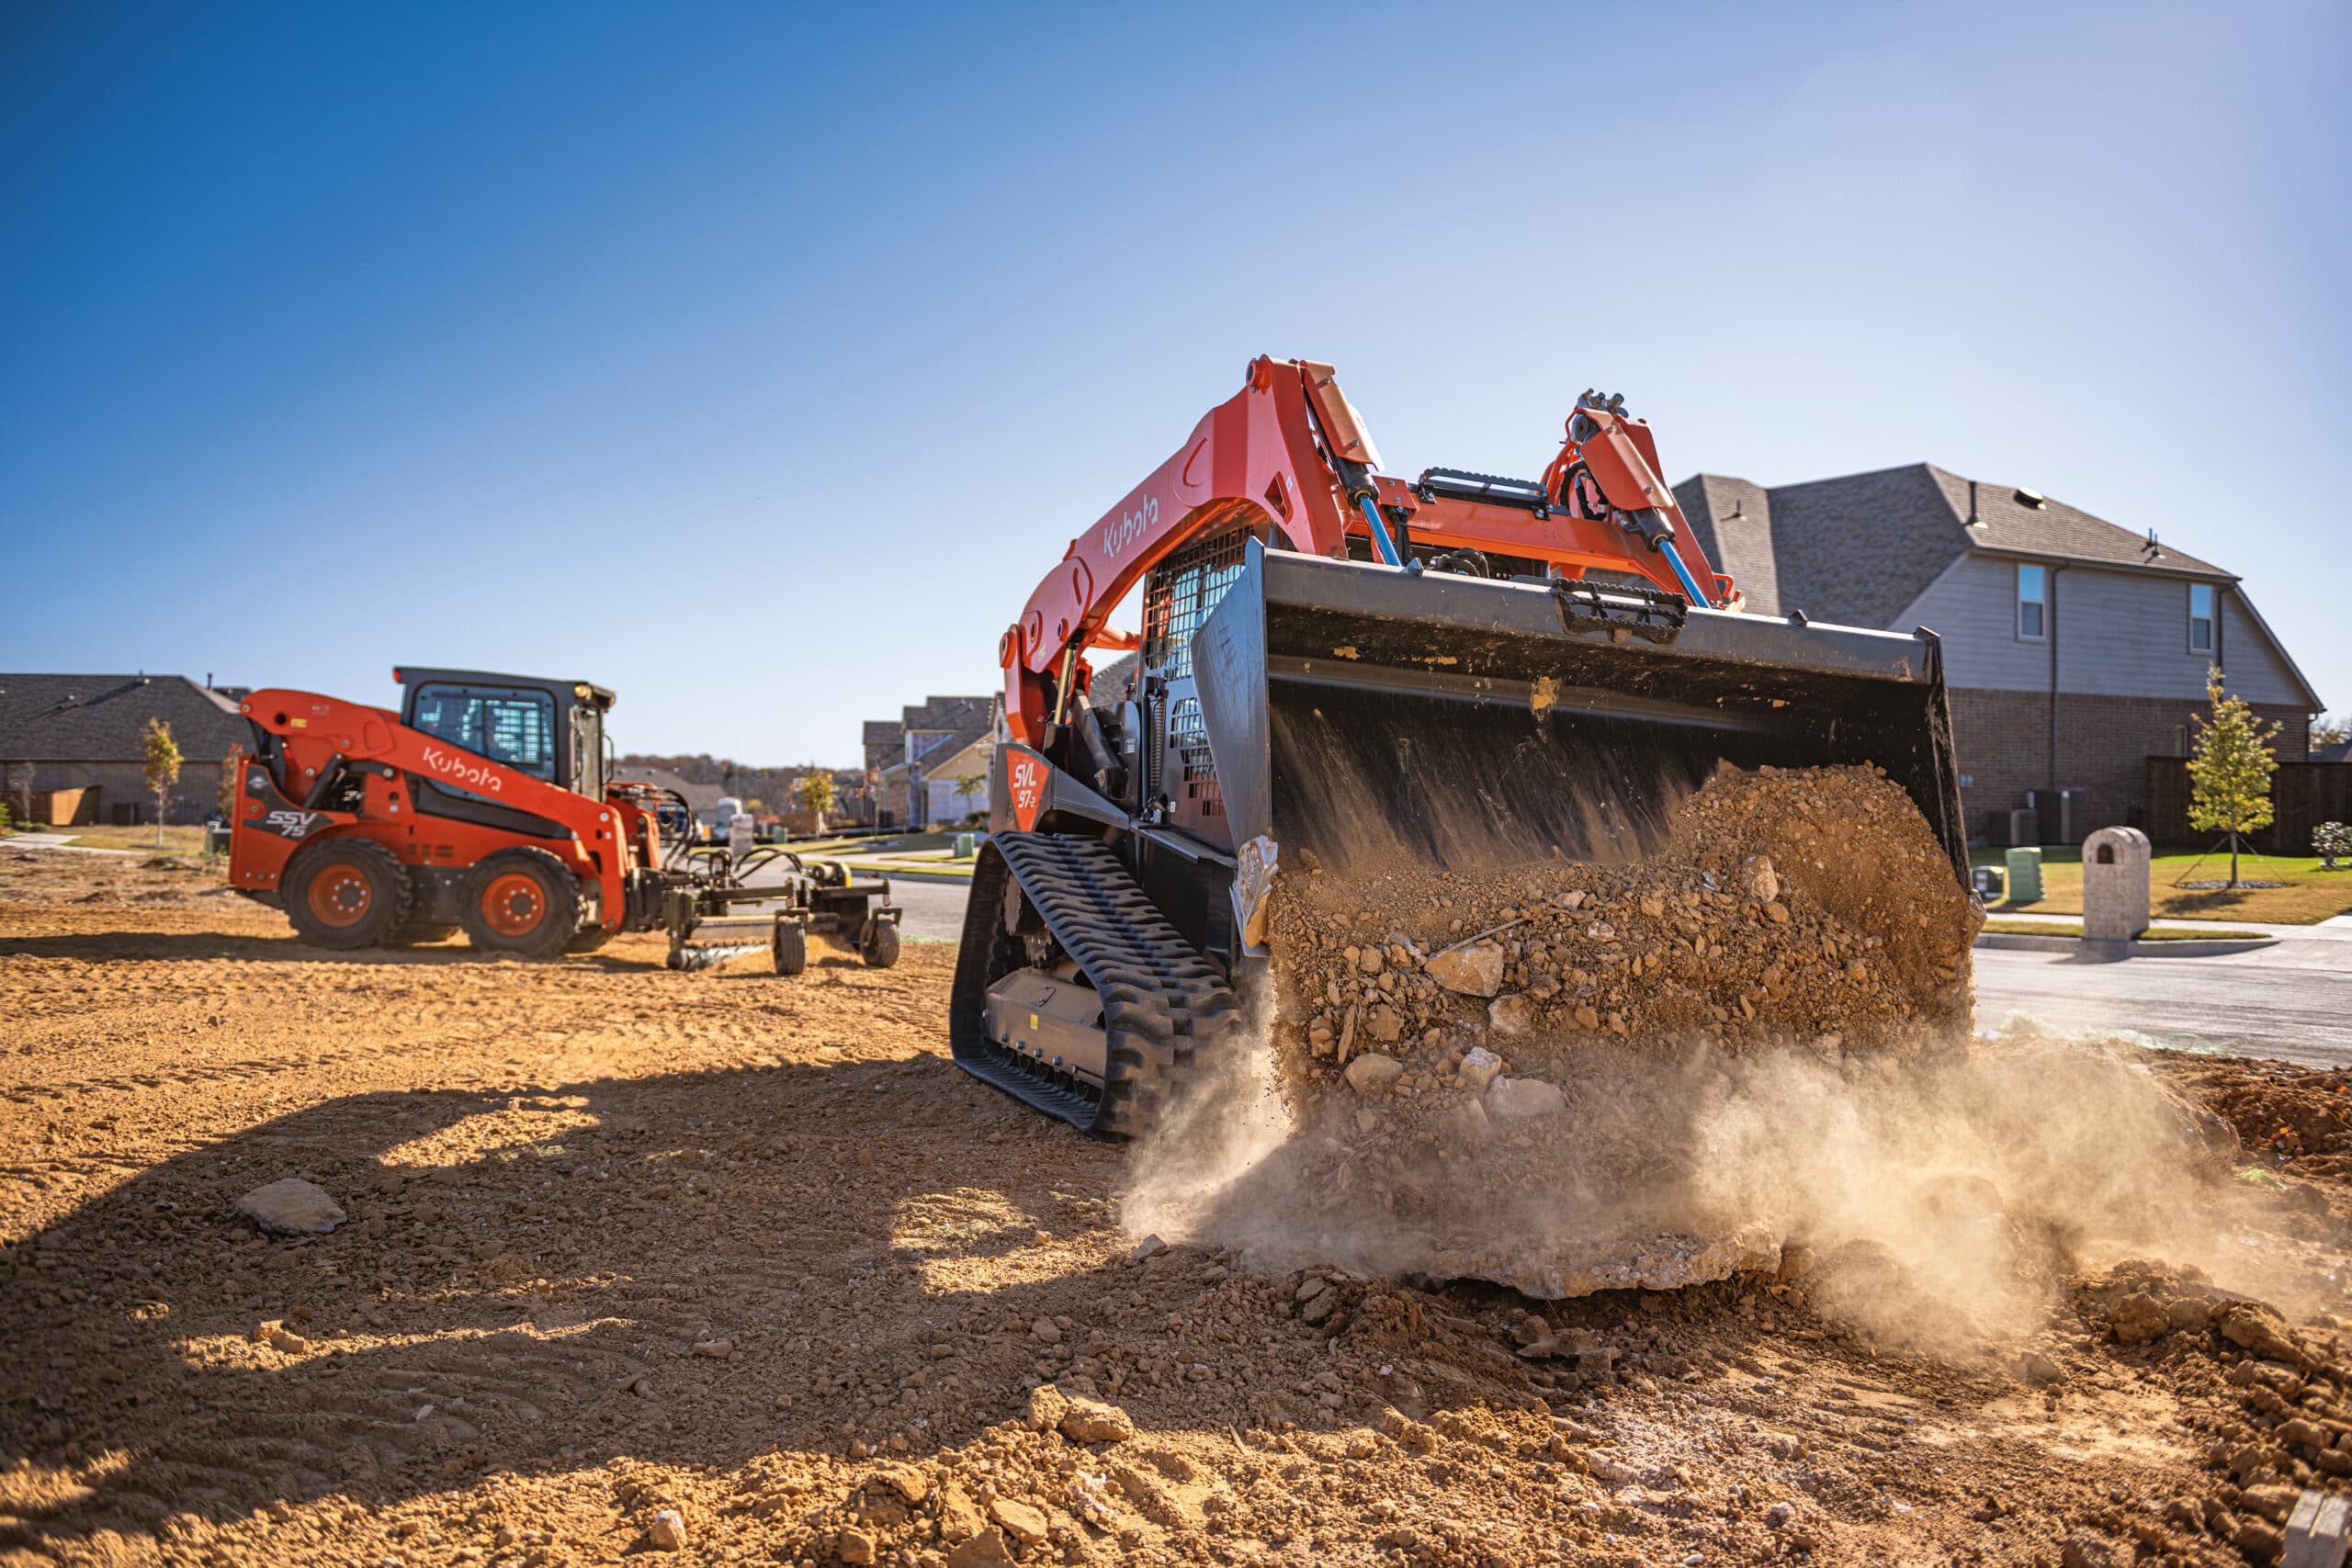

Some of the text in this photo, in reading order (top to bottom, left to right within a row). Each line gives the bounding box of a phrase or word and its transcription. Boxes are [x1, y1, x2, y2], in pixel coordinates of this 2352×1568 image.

[1103, 493, 1159, 559] Kubota
[423, 747, 502, 792] Kubota
[1012, 762, 1037, 788] SVL
[266, 810, 318, 825] SSV
[280, 824, 307, 837] 75
